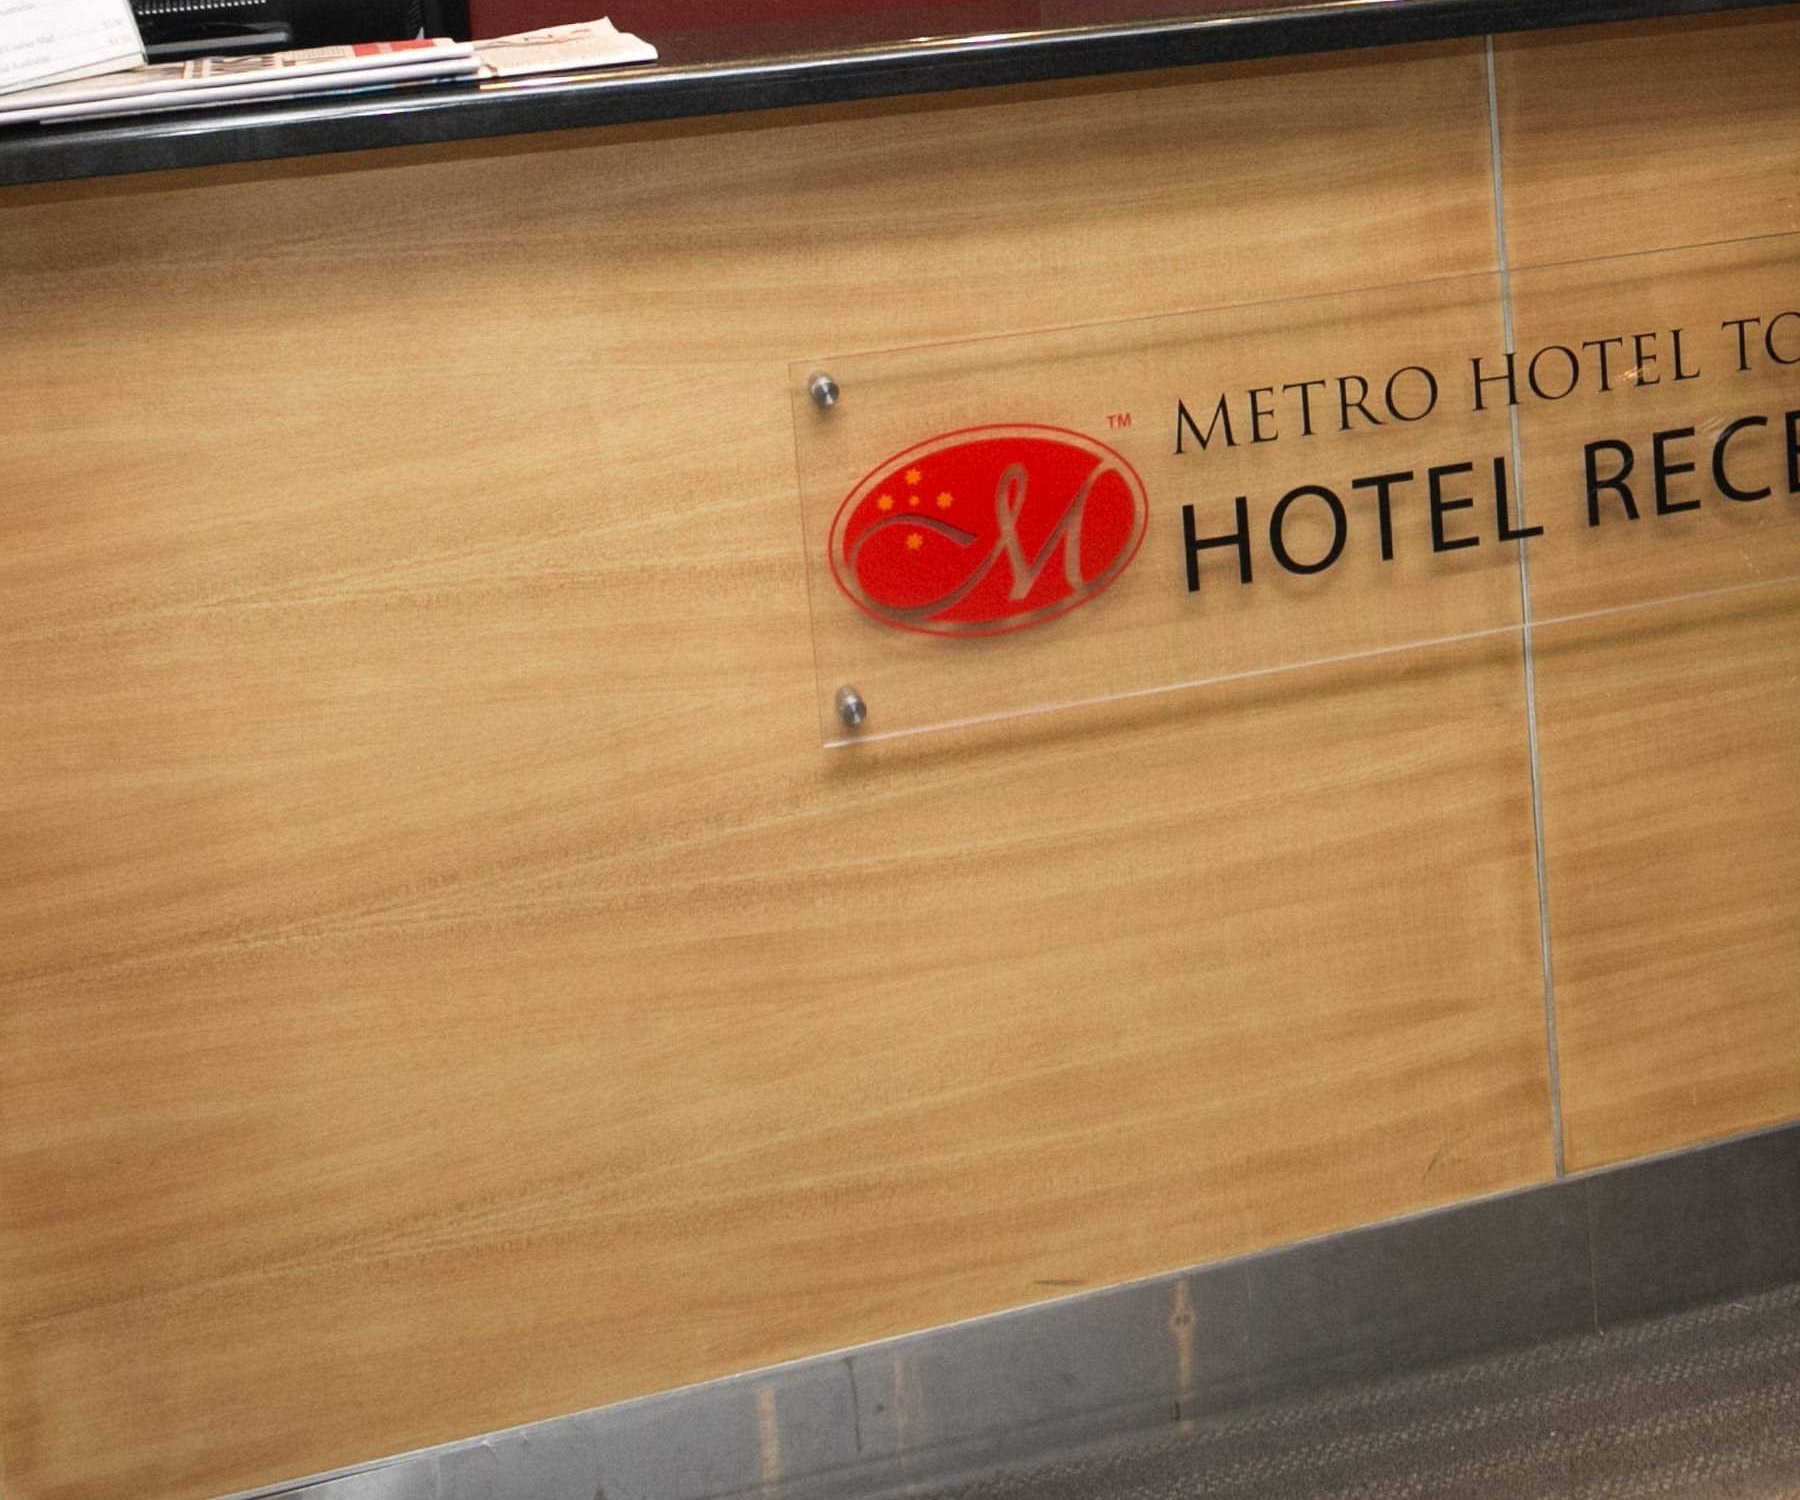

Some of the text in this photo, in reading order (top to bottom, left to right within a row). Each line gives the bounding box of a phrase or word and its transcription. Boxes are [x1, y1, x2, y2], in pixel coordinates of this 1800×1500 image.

[1106, 413, 1132, 429] TM
[1173, 366, 1438, 455] METRO
[1470, 328, 1701, 411] HOTEL
[1182, 457, 1544, 593] HOTEL
